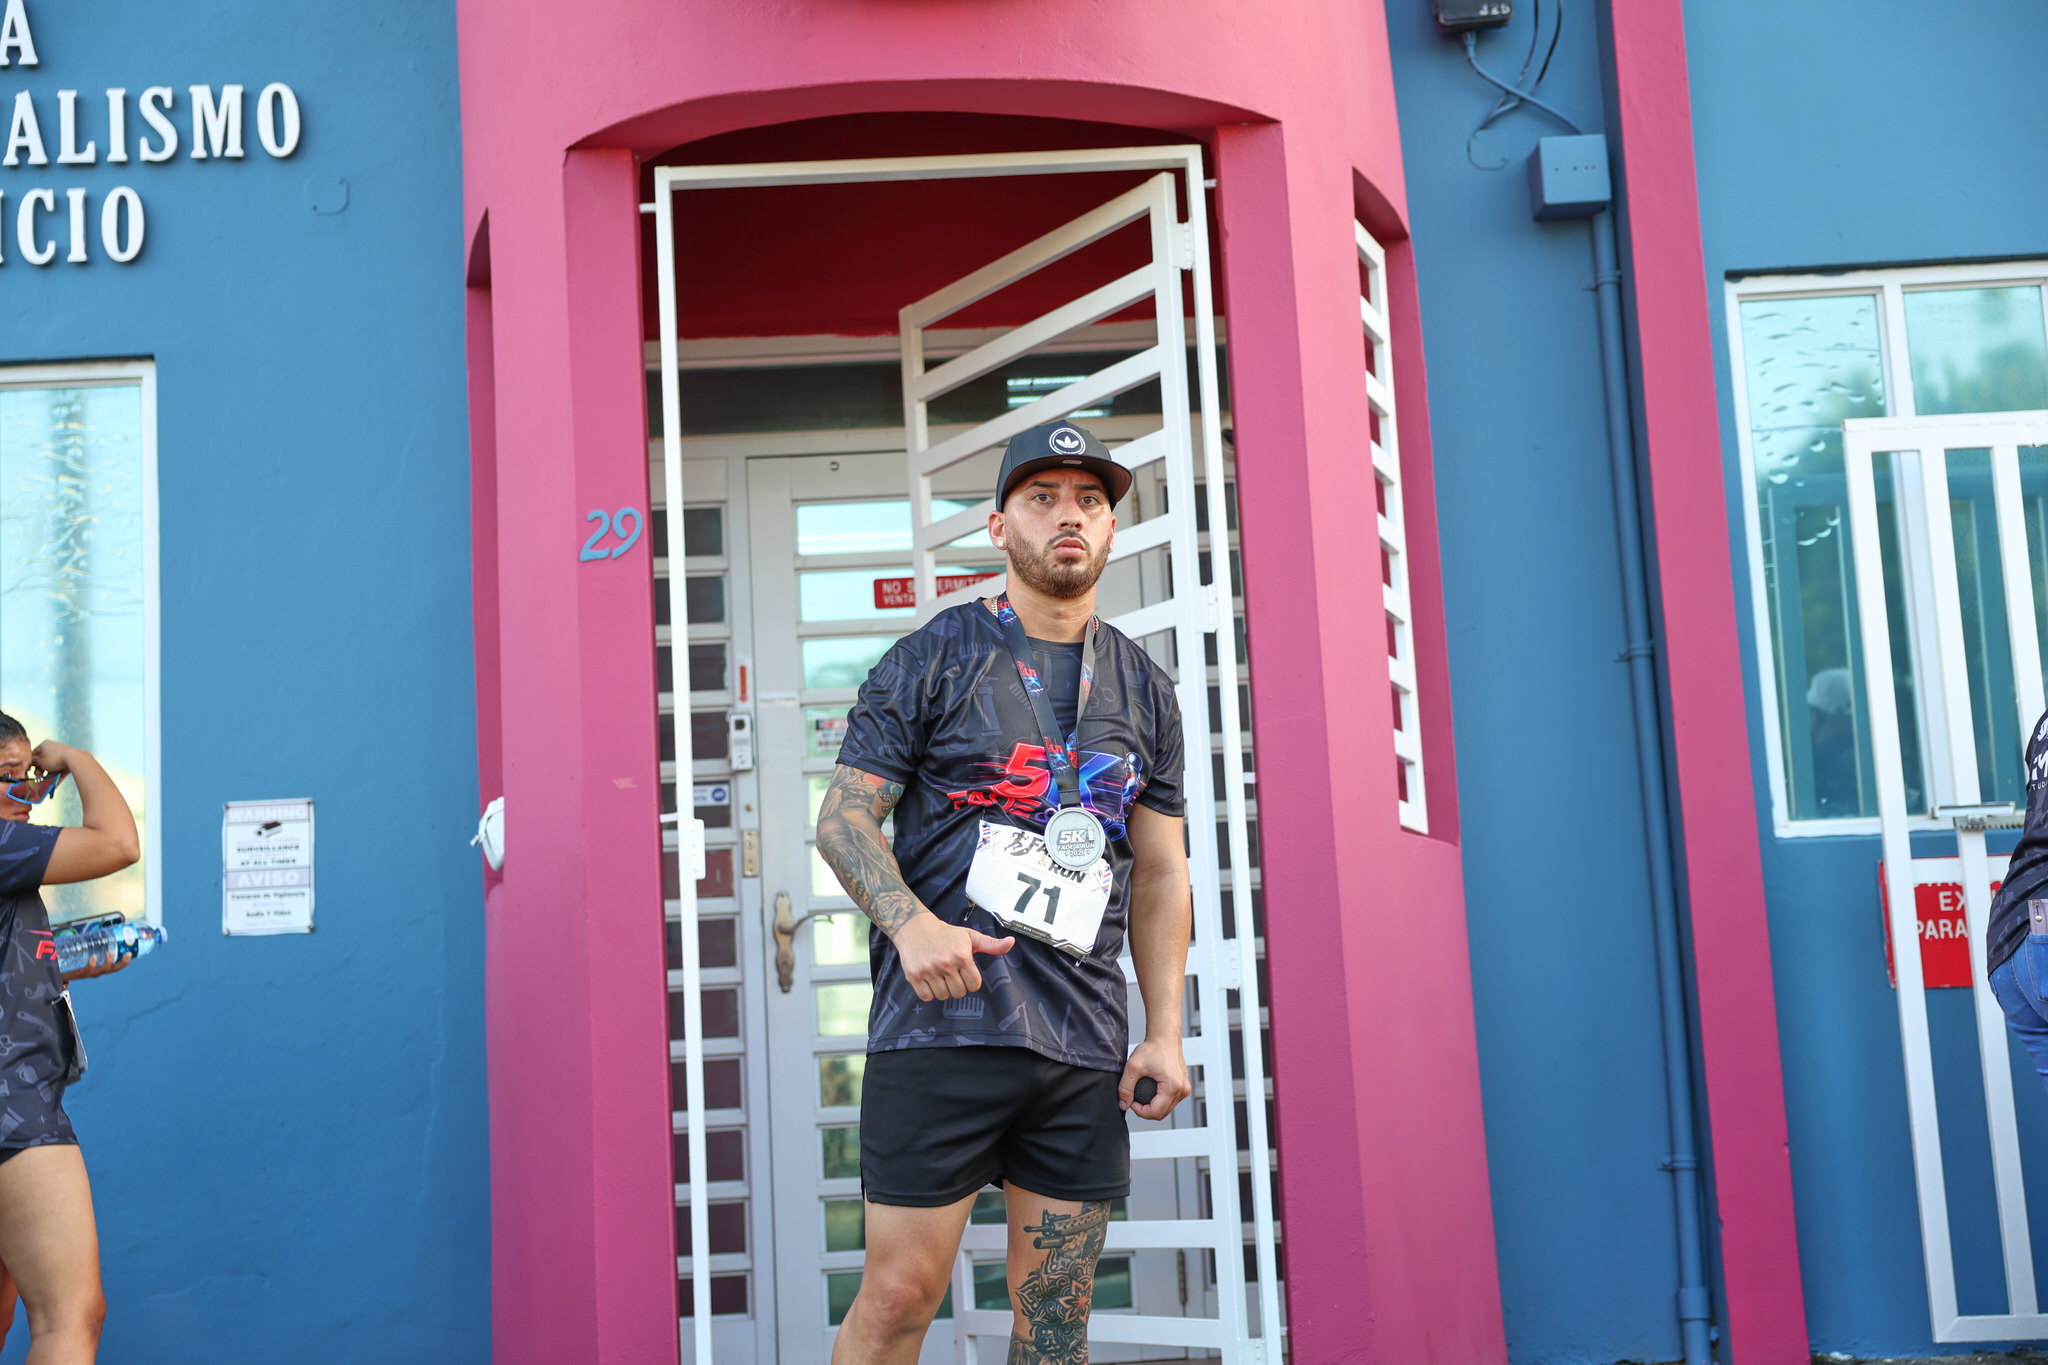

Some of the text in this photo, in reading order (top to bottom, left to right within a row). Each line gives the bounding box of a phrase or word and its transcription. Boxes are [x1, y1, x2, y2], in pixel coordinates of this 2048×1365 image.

[0, 0, 39, 66] A
[2, 82, 300, 166] ALISMO
[0, 186, 145, 265] CIO
[580, 507, 643, 562] 29
[881, 581, 902, 594] NO
[906, 580, 916, 593] S
[238, 871, 299, 887] AVISO
[1013, 872, 1061, 925] 71
[1048, 861, 1087, 883] RUN
